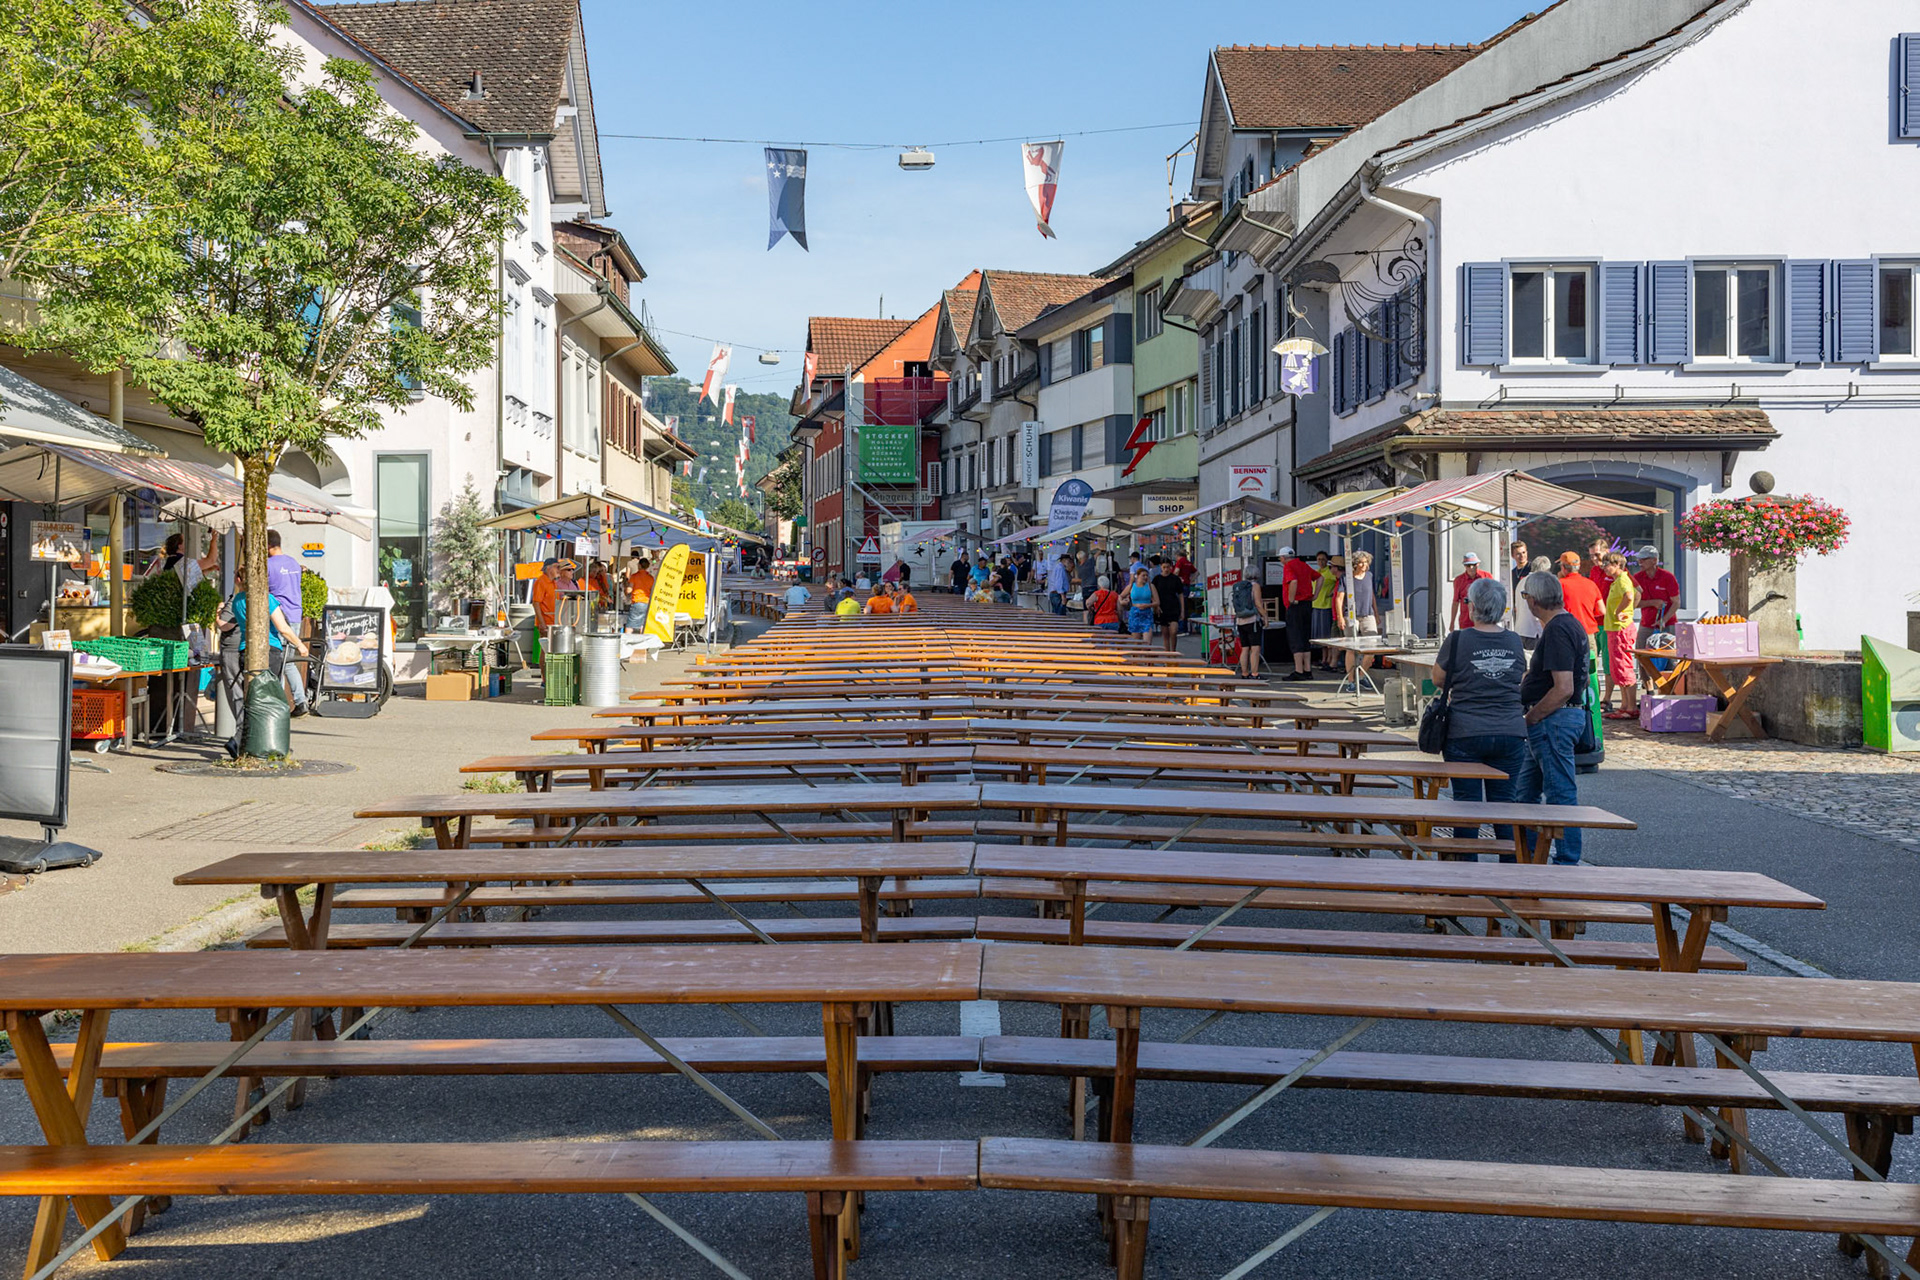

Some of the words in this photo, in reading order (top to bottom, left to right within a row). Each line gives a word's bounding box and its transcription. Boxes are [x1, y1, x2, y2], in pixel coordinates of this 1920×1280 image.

[1058, 494, 1088, 503] Kiwanis
[1054, 508, 1079, 516] Kiwanis
[1158, 504, 1185, 512] SHOP
[683, 573, 700, 584] ege
[678, 590, 697, 600] rick
